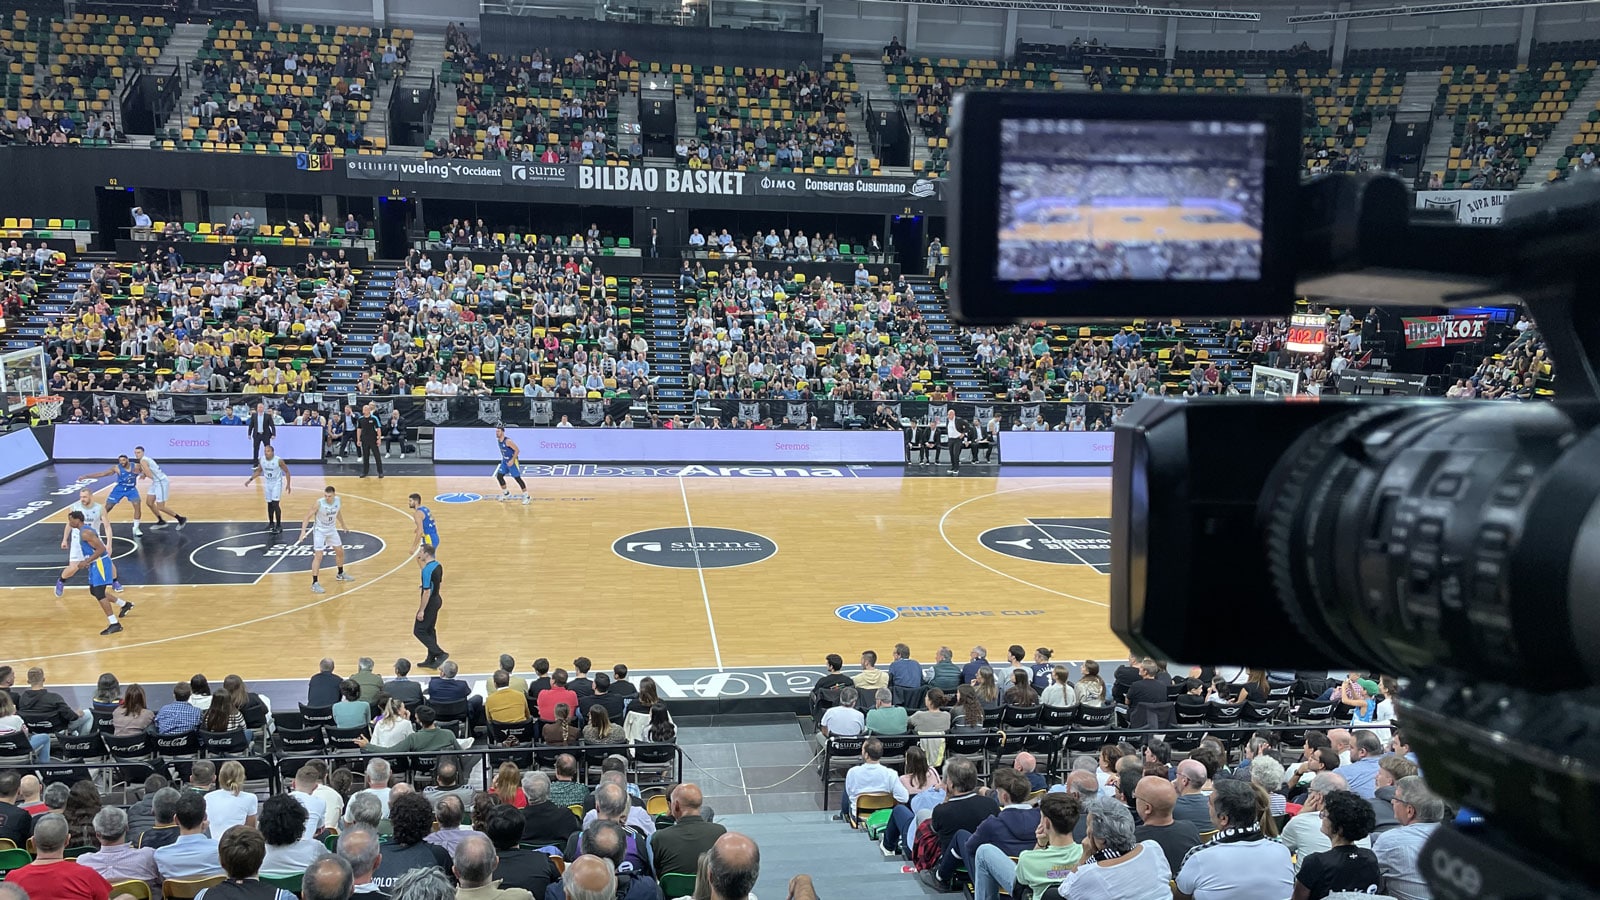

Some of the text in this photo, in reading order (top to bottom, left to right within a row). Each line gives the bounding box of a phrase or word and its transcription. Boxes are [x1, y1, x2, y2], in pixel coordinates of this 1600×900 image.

[400, 160, 448, 178] vueling
[462, 166, 501, 177] Occident
[528, 166, 566, 176] surne
[579, 166, 745, 195] BILBAO BASKET
[772, 180, 796, 190] IMQ
[805, 178, 906, 193] Conservas Cusumano
[1467, 197, 1489, 213] AUPA
[169, 438, 210, 447] Seremos
[540, 440, 576, 449] Seremos
[775, 442, 810, 451] Seremos
[678, 464, 842, 477] Arena
